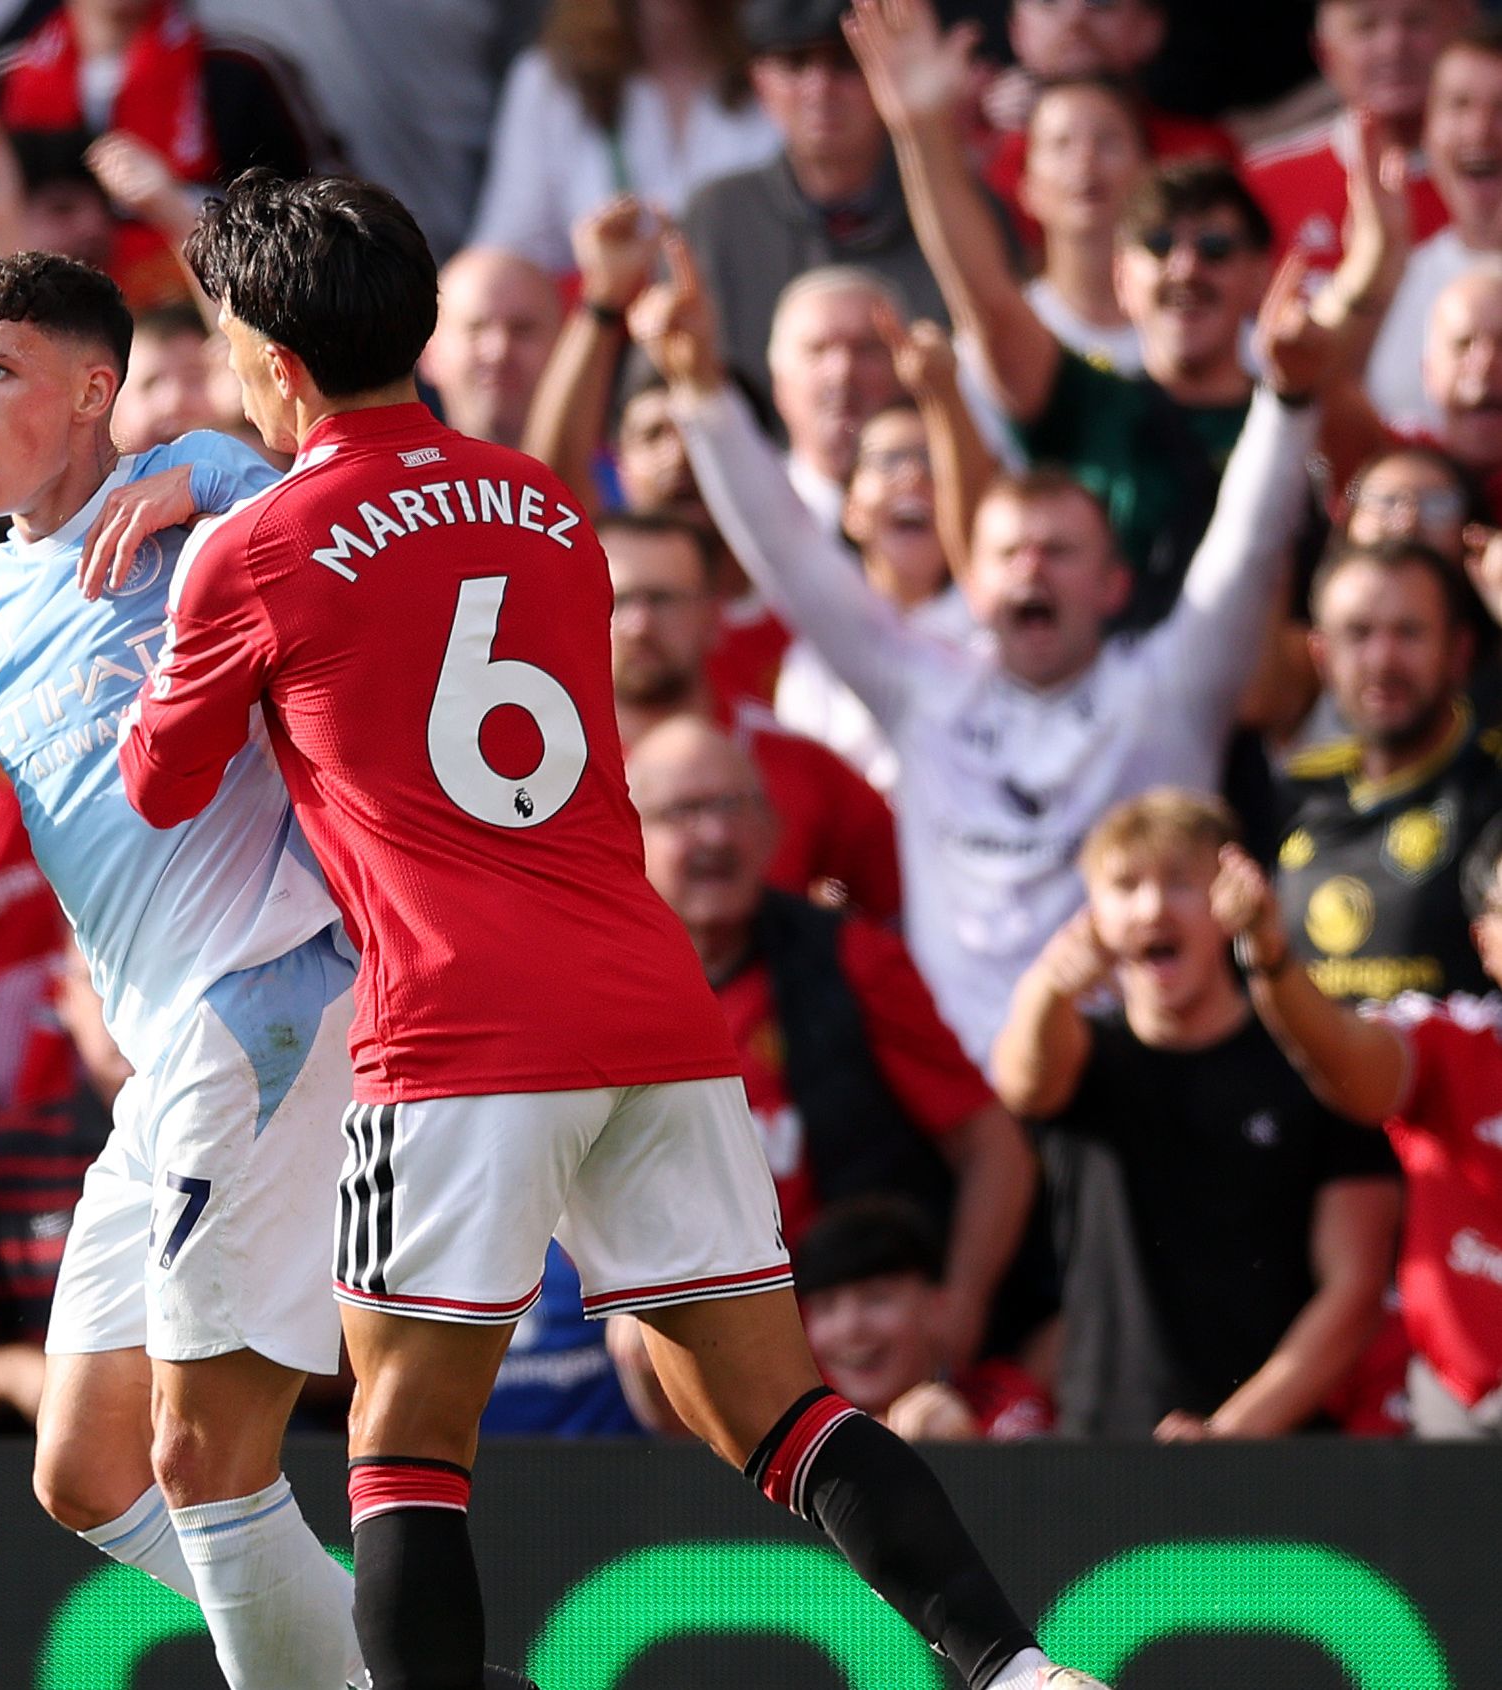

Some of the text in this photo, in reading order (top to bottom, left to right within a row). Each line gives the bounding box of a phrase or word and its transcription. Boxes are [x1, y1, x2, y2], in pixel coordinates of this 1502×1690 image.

[399, 447, 442, 467] UNITED
[310, 478, 581, 584] MARTINEZ
[427, 574, 589, 829] 6
[149, 1170, 212, 1270] 7
